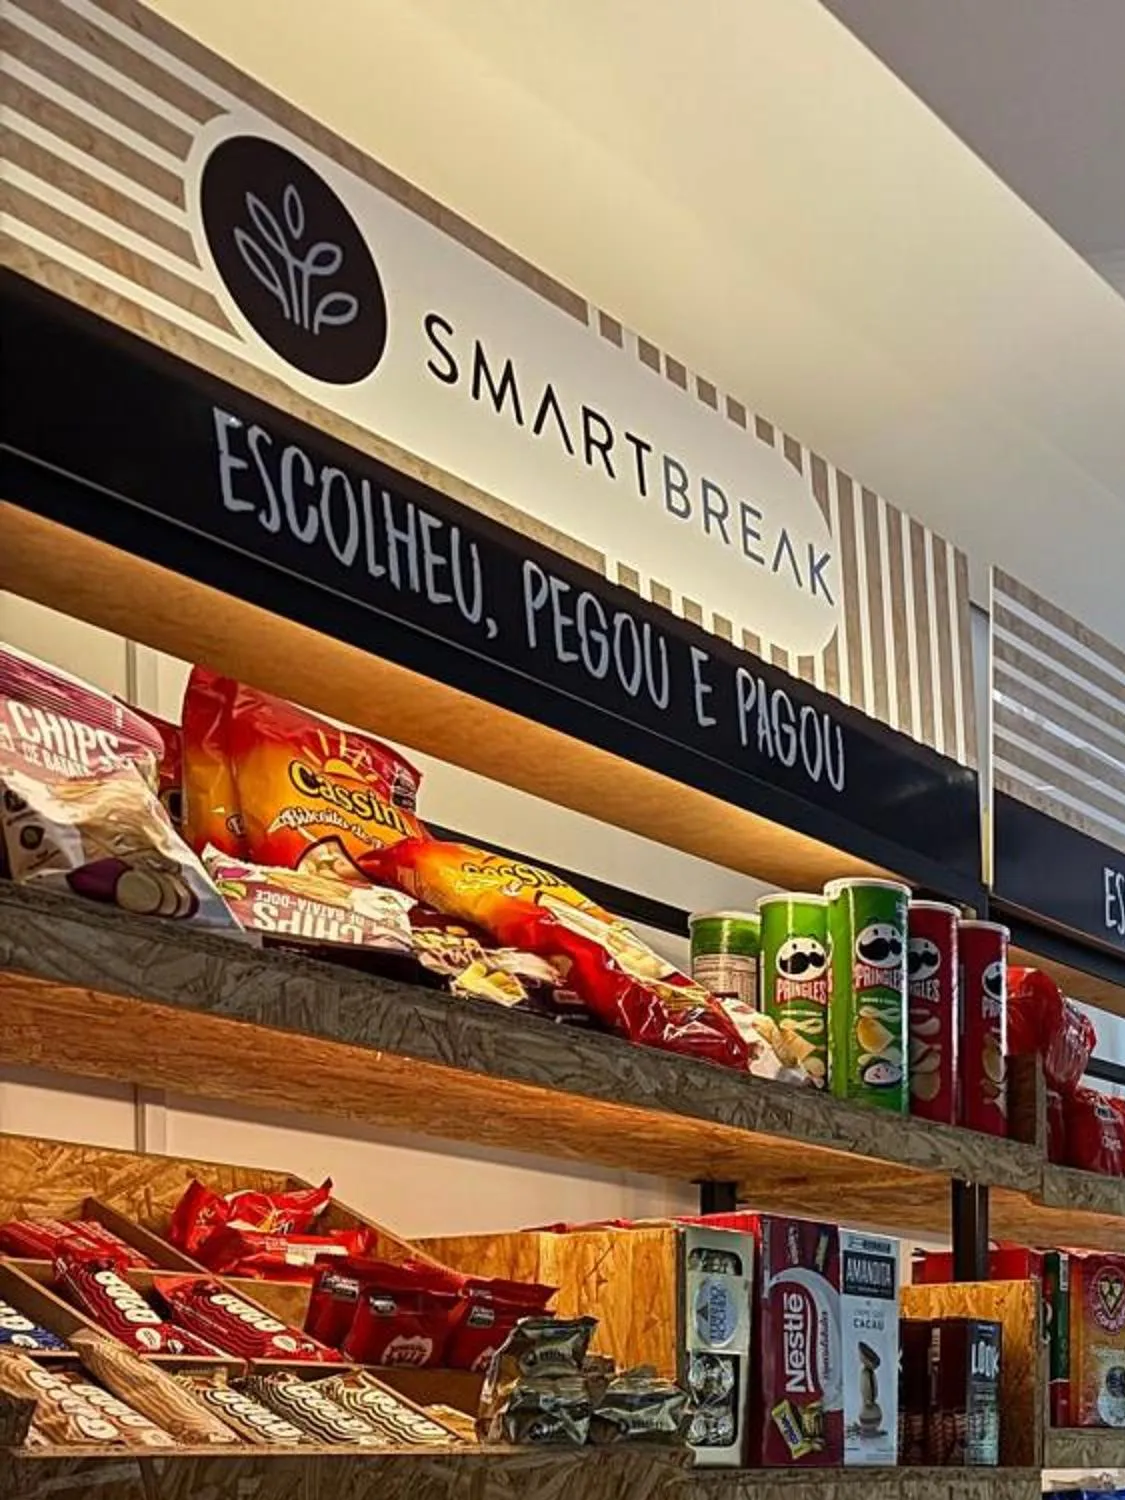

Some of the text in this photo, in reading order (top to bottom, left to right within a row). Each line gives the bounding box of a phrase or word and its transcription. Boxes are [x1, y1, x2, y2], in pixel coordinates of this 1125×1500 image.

[212, 406, 847, 793] ESCOLHEU, PEGOU E PAGOU
[423, 313, 836, 606] SMARTBREAK
[776, 977, 827, 1003] PRINGLES
